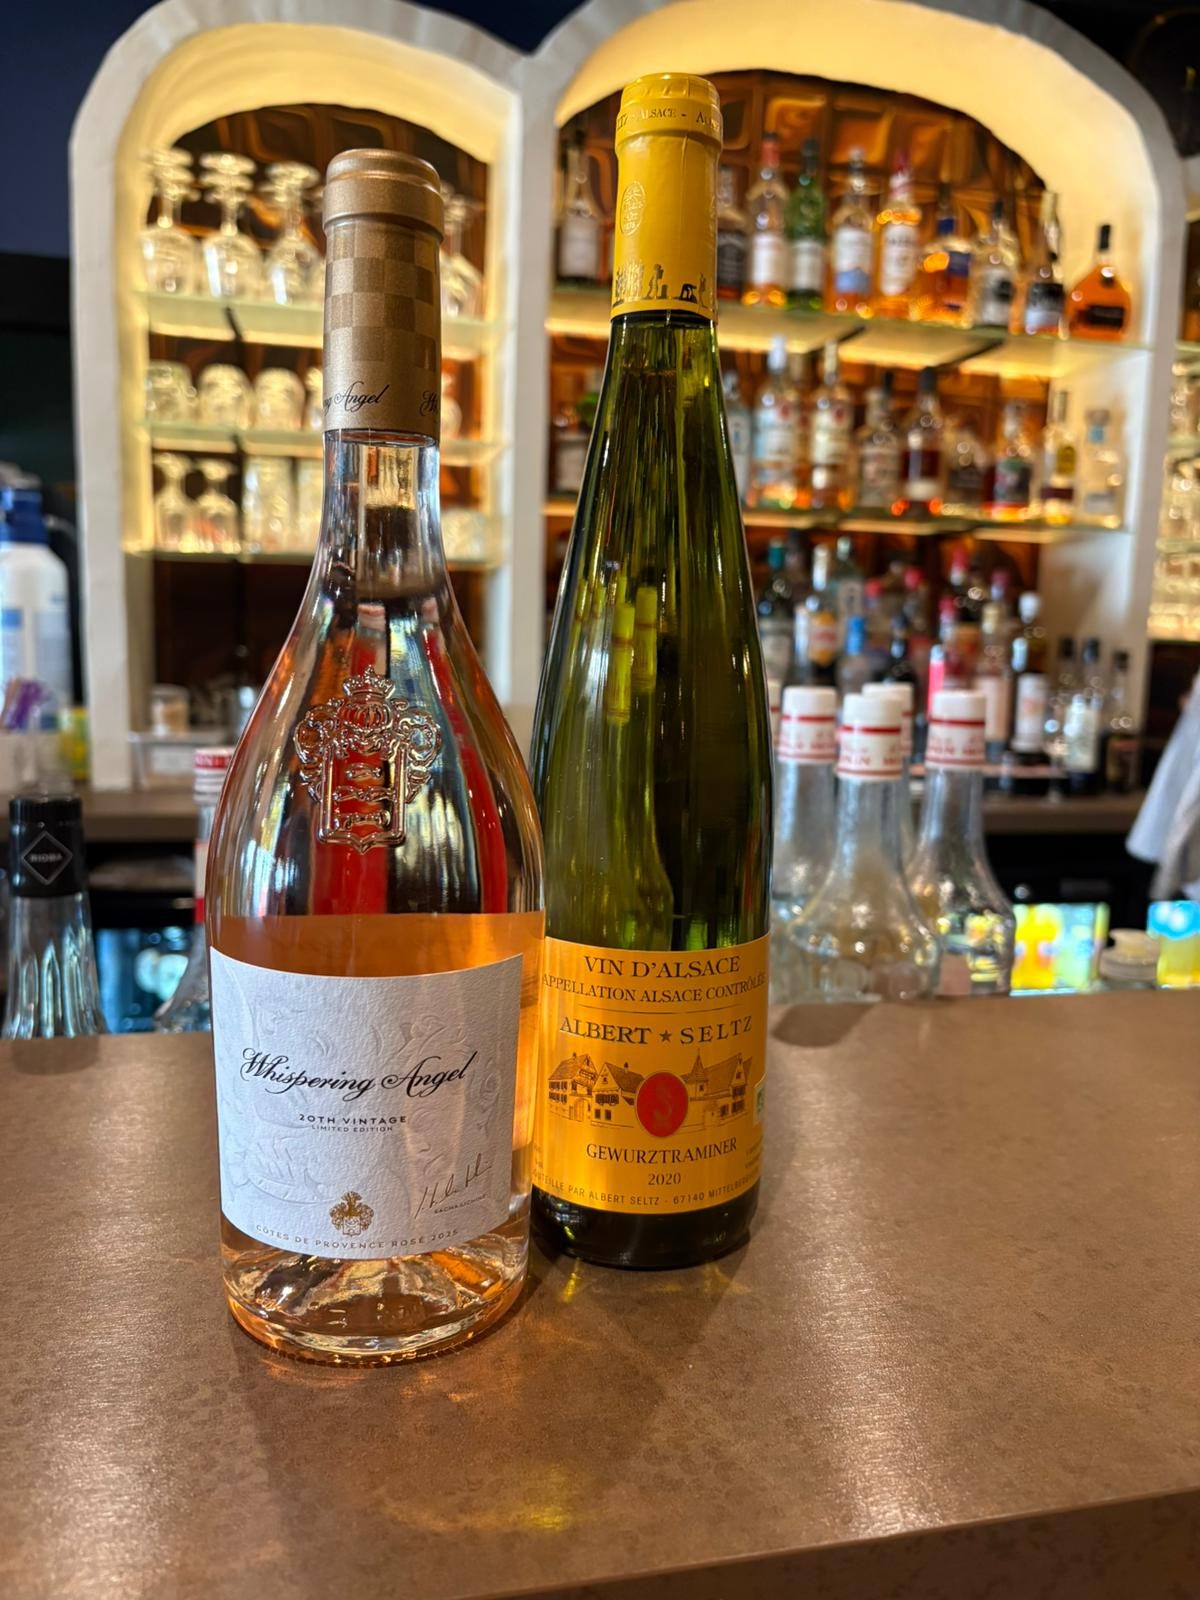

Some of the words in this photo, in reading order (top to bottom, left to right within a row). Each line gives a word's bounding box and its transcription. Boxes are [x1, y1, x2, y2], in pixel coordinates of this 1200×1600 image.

[333, 380, 390, 413] Angel
[584, 955, 624, 976] VIN
[632, 955, 741, 979] D'ALSACE
[541, 973, 636, 1001] APPELLATION
[640, 988, 702, 1003] ALSACE
[559, 1016, 652, 1045] ALBERT
[680, 1015, 752, 1045] SELTZ
[239, 1047, 376, 1102] Whispering
[381, 1050, 479, 1099] Angel
[299, 1113, 336, 1125] 20TH
[342, 1115, 407, 1126] VINTAGE
[311, 1124, 350, 1133] LIMITED
[353, 1125, 393, 1133] EDITION
[586, 1136, 737, 1165] GEWURZTRAMINER
[647, 1172, 681, 1186] 2020
[568, 1184, 586, 1198] PAR
[588, 1190, 625, 1205] ALBERT
[630, 1195, 660, 1206] SELTZ
[673, 1191, 705, 1205] 67140
[295, 1236, 309, 1245] DE
[315, 1239, 385, 1249] PROVENCE
